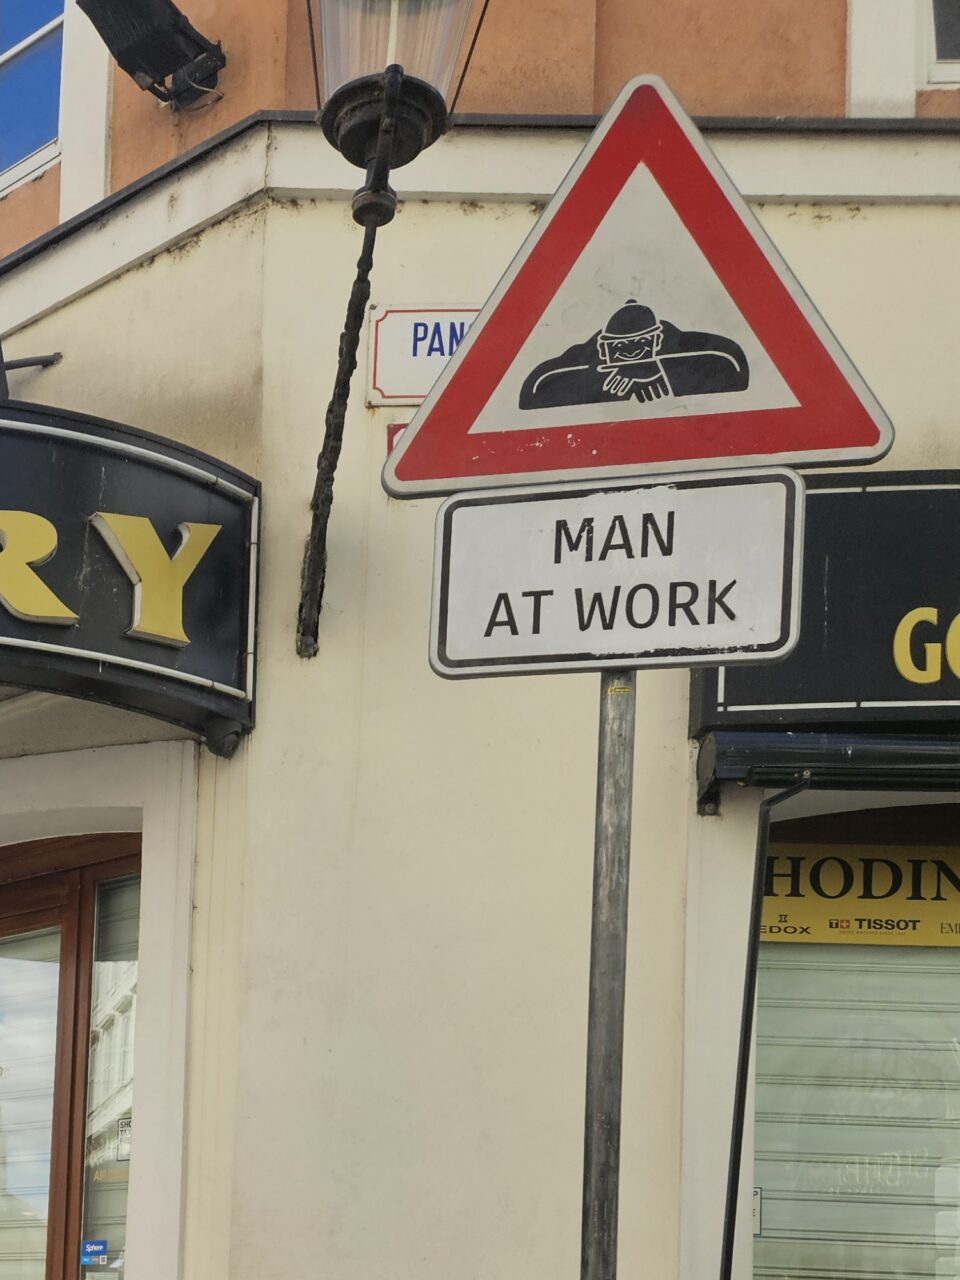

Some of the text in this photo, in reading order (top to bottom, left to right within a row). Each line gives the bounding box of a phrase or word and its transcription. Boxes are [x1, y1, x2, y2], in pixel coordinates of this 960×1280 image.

[412, 321, 473, 357] PAN
[553, 510, 676, 564] MAN
[483, 578, 737, 638] AT WORK
[893, 606, 960, 684] G
[854, 918, 921, 931] TISSOT
[940, 922, 960, 935] EM
